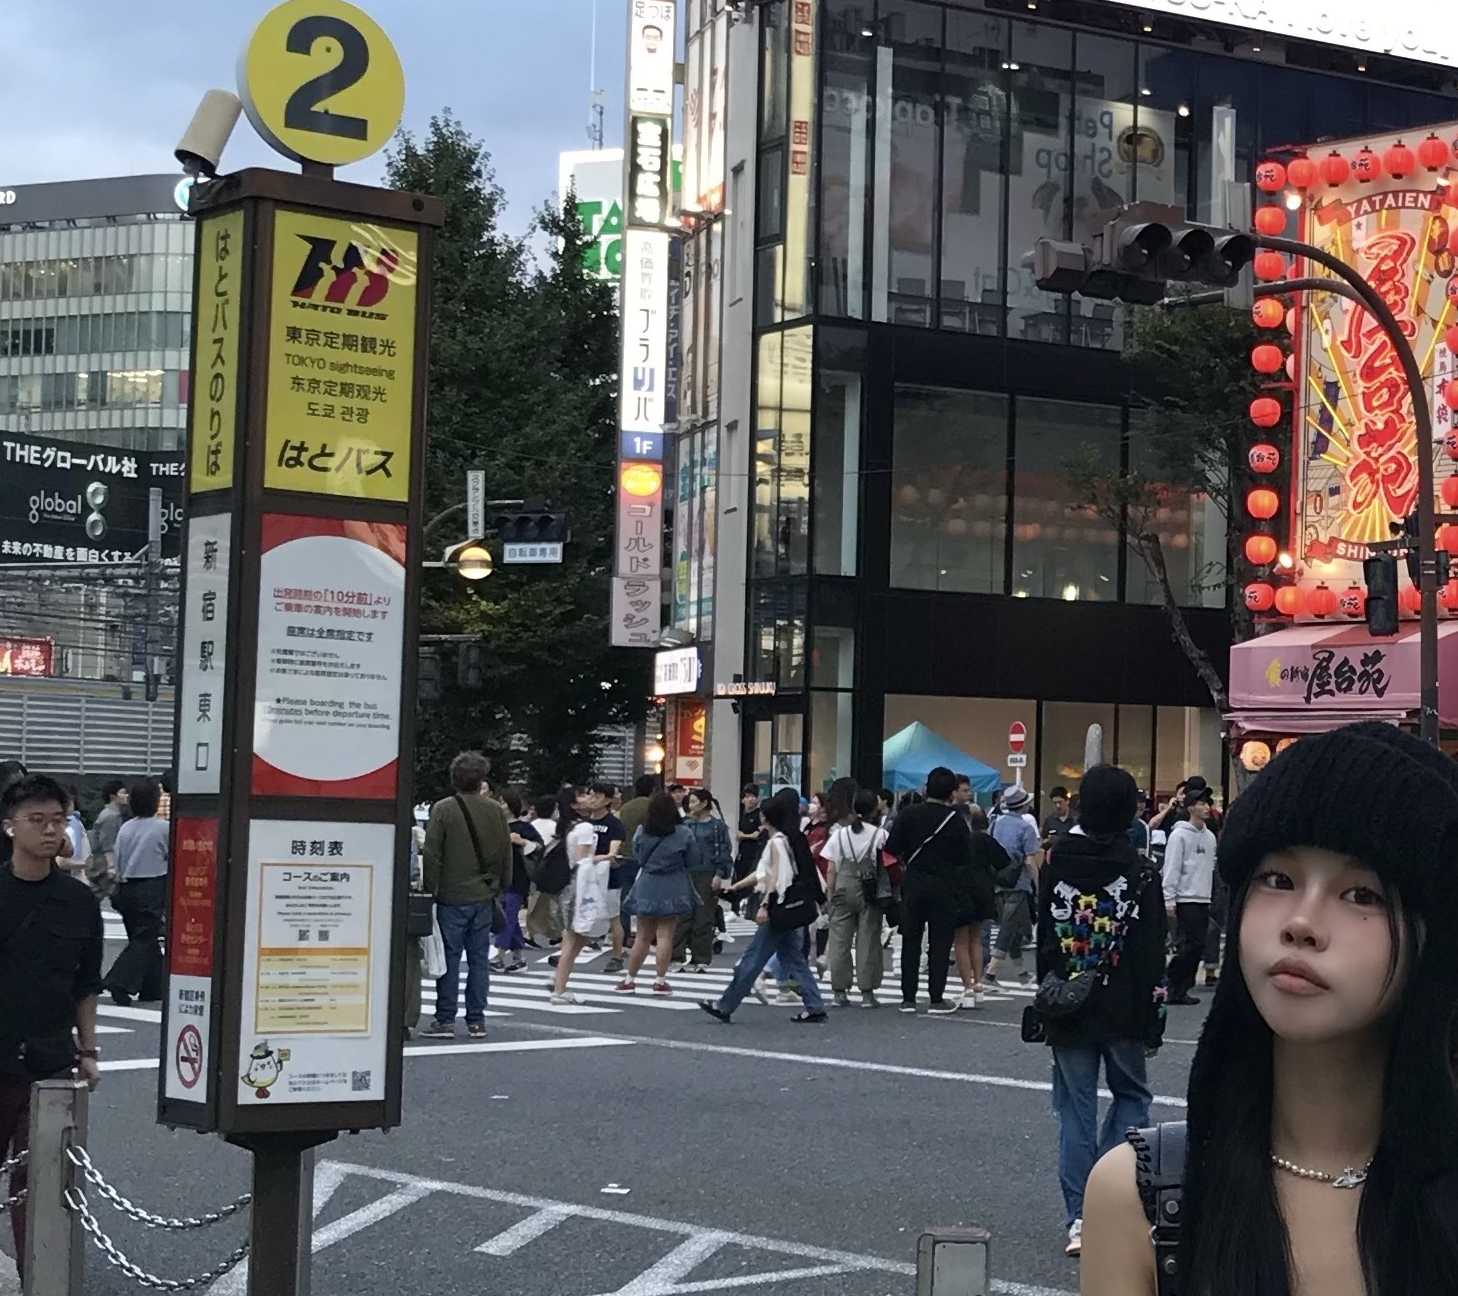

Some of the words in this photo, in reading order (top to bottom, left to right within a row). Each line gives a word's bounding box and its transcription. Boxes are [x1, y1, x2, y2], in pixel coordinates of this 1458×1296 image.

[283, 15, 371, 142] 2
[1346, 192, 1432, 219] YATAIEN
[290, 299, 341, 315] HATO
[344, 308, 389, 321] BUS
[205, 227, 231, 478] はとバスのりば
[285, 325, 397, 358] 東京定期観光
[284, 353, 327, 372] TOKYO
[328, 361, 396, 381] sightseeing
[290, 376, 388, 403] 东京定期观光
[306, 402, 336, 418] 도쿄
[340, 407, 370, 425] 관광
[2, 441, 139, 478] THEグローバル社
[277, 439, 396, 479] はとバス
[633, 436, 654, 455] 1F
[28, 489, 82, 524] global
[622, 502, 656, 645] ゴールドラッシュ
[195, 539, 218, 771] 新宿駅東口
[1303, 649, 1392, 704] 屋台苑
[304, 707, 331, 717] before
[332, 709, 371, 723] departure
[291, 839, 344, 857] 時刻表
